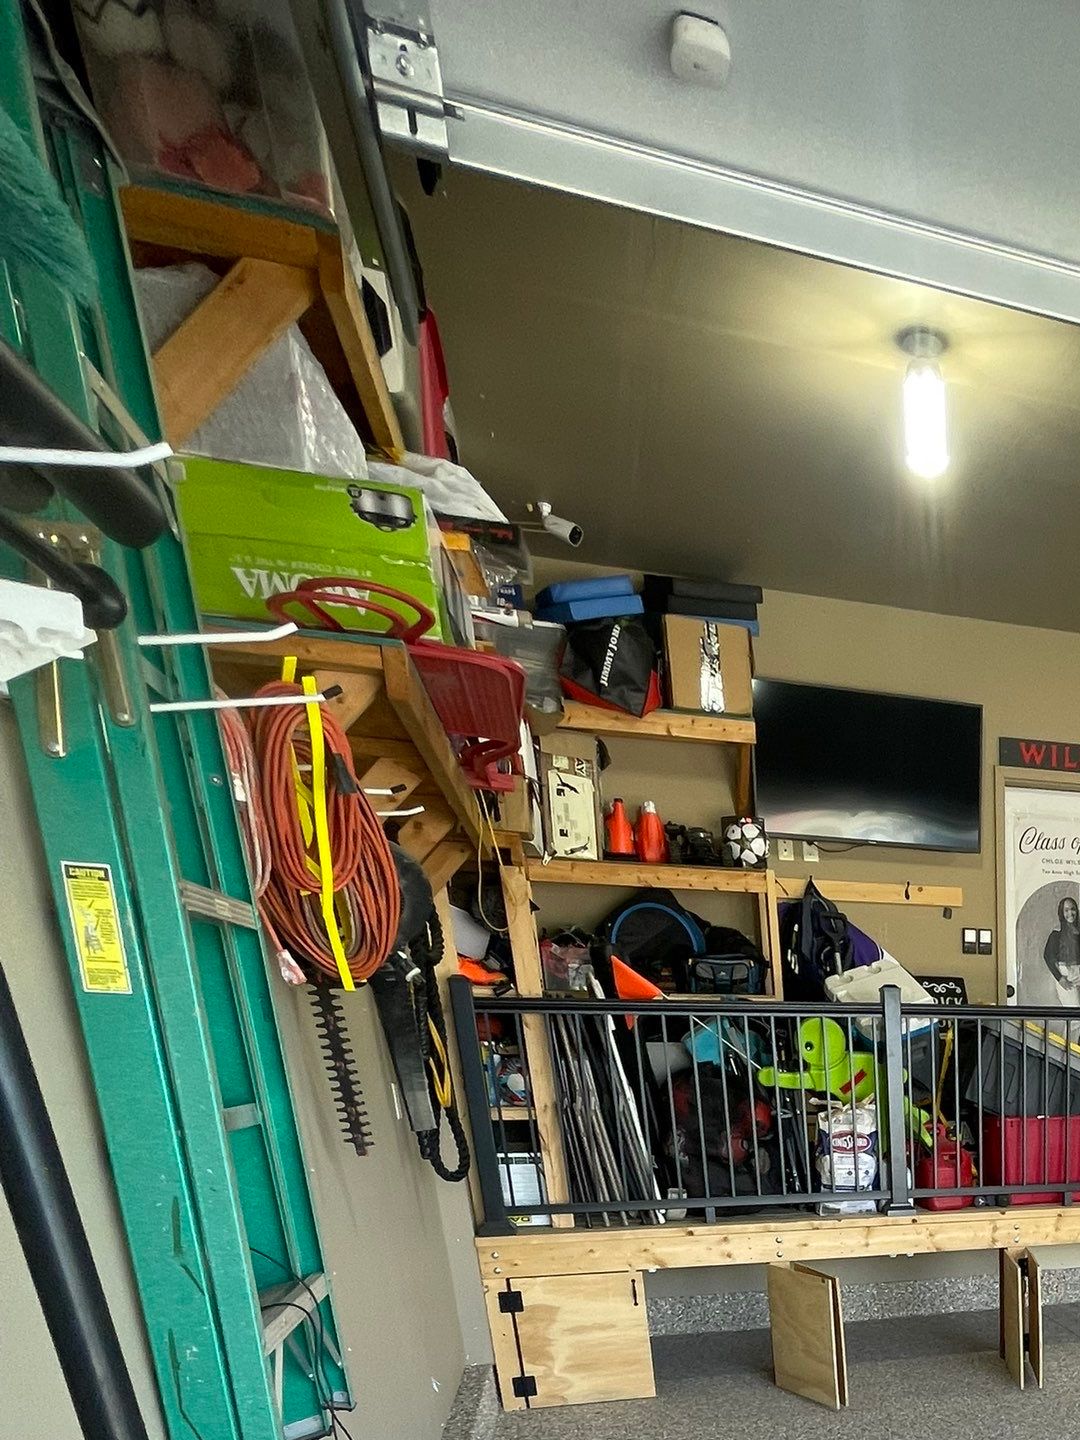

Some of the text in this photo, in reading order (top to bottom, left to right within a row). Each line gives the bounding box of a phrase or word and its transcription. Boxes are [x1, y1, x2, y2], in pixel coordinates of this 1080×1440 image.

[230, 566, 370, 616] ARMA
[600, 648, 615, 687] JIMMY
[1019, 826, 1066, 855] Class
